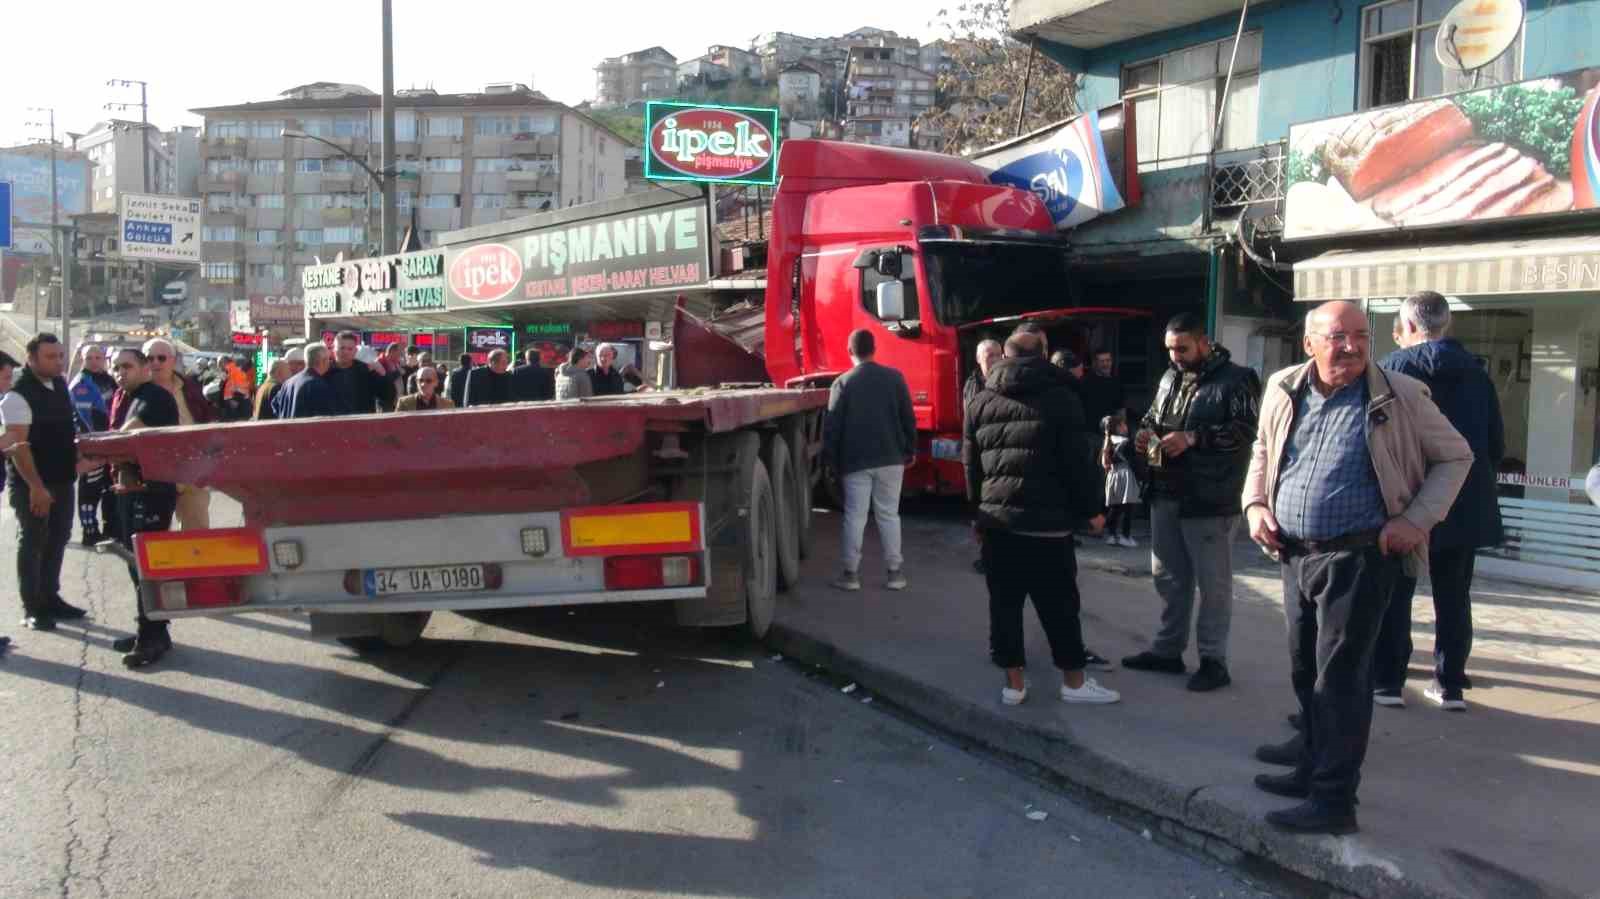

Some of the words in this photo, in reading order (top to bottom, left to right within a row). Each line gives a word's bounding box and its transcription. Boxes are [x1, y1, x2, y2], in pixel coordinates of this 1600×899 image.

[661, 118, 768, 161] ipek
[127, 222, 171, 233] Ankara
[400, 254, 440, 277] SARAY
[471, 331, 507, 348] ipek
[377, 570, 398, 592] 34
[409, 569, 433, 590] UA
